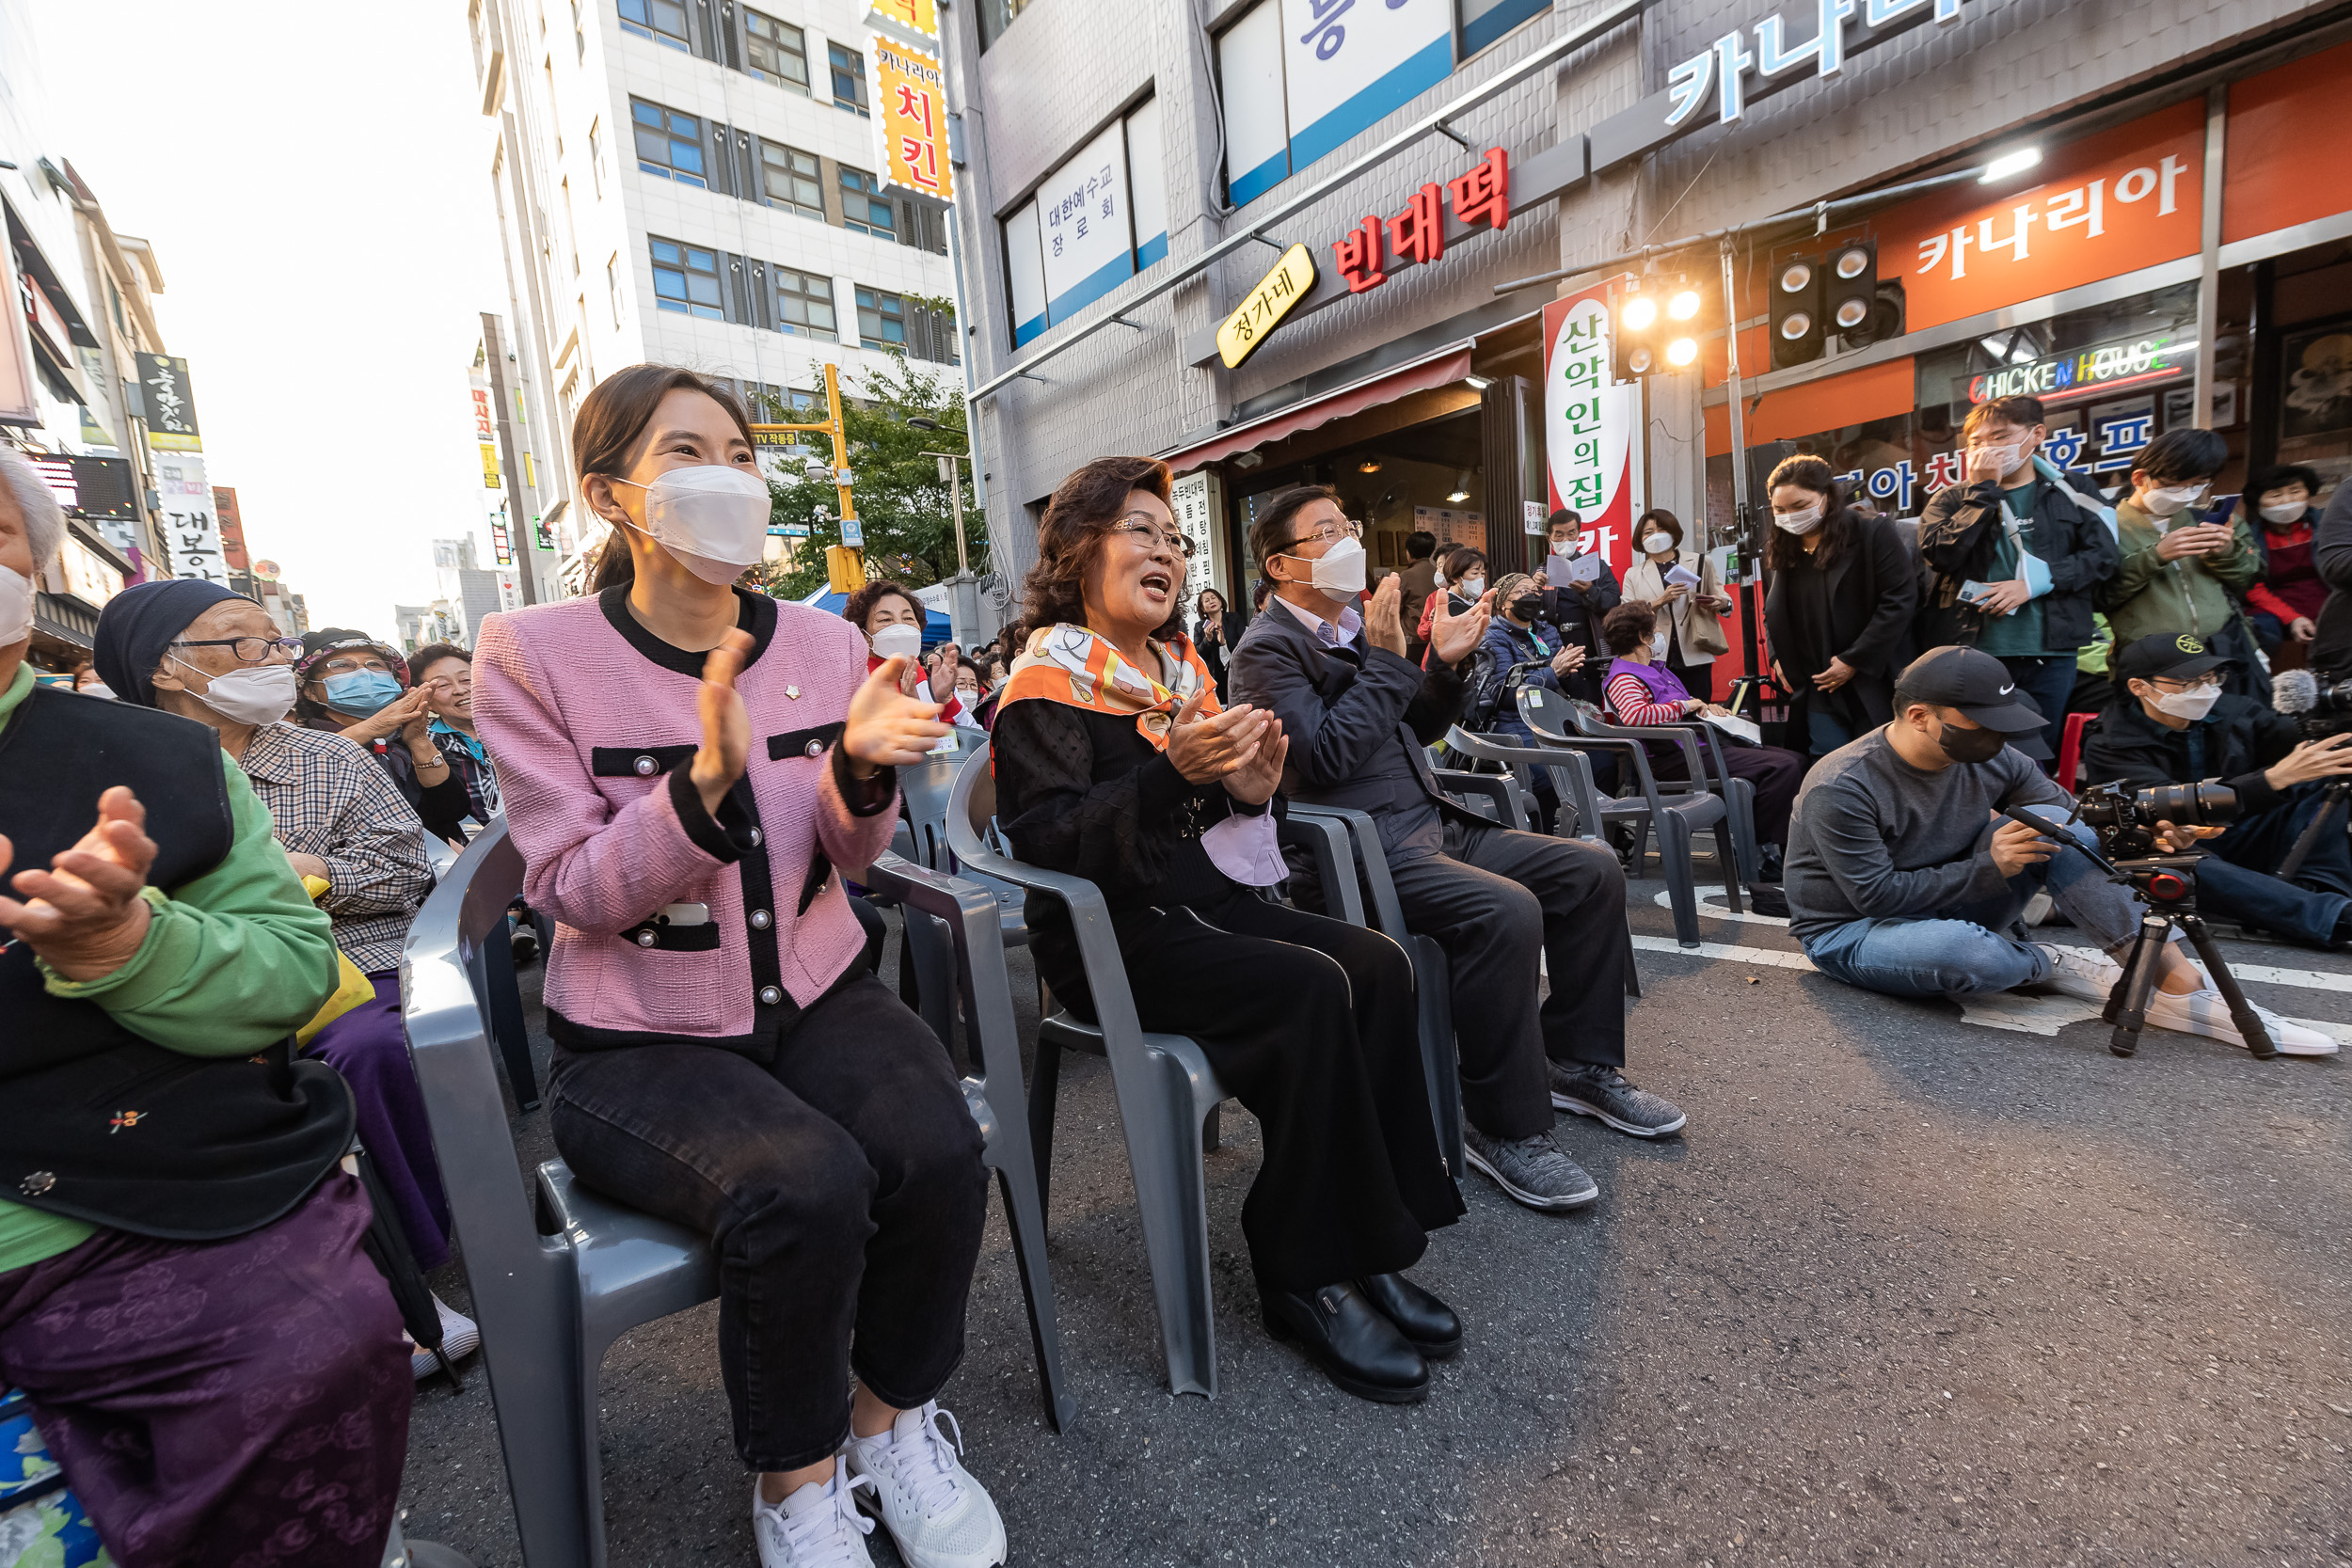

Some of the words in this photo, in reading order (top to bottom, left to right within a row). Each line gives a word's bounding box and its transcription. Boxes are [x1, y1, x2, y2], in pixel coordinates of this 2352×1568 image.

[881, 50, 940, 89] 카나리아
[897, 84, 938, 189] 치킨
[1049, 164, 1112, 228] 대한예수교
[1053, 194, 1113, 257] 장로회
[1332, 146, 1509, 294] 빈대떡
[1916, 153, 2188, 280] 카나리아
[1233, 267, 1295, 341] 정가네
[1969, 361, 2074, 404] CHICKEN
[2077, 339, 2170, 382] HOUSE
[755, 434, 768, 444] TV
[769, 433, 795, 445] 작동중
[2040, 415, 2153, 475] 호프
[1172, 479, 1204, 502] 녹두빈대떡
[1527, 505, 1546, 518] 정기휴일
